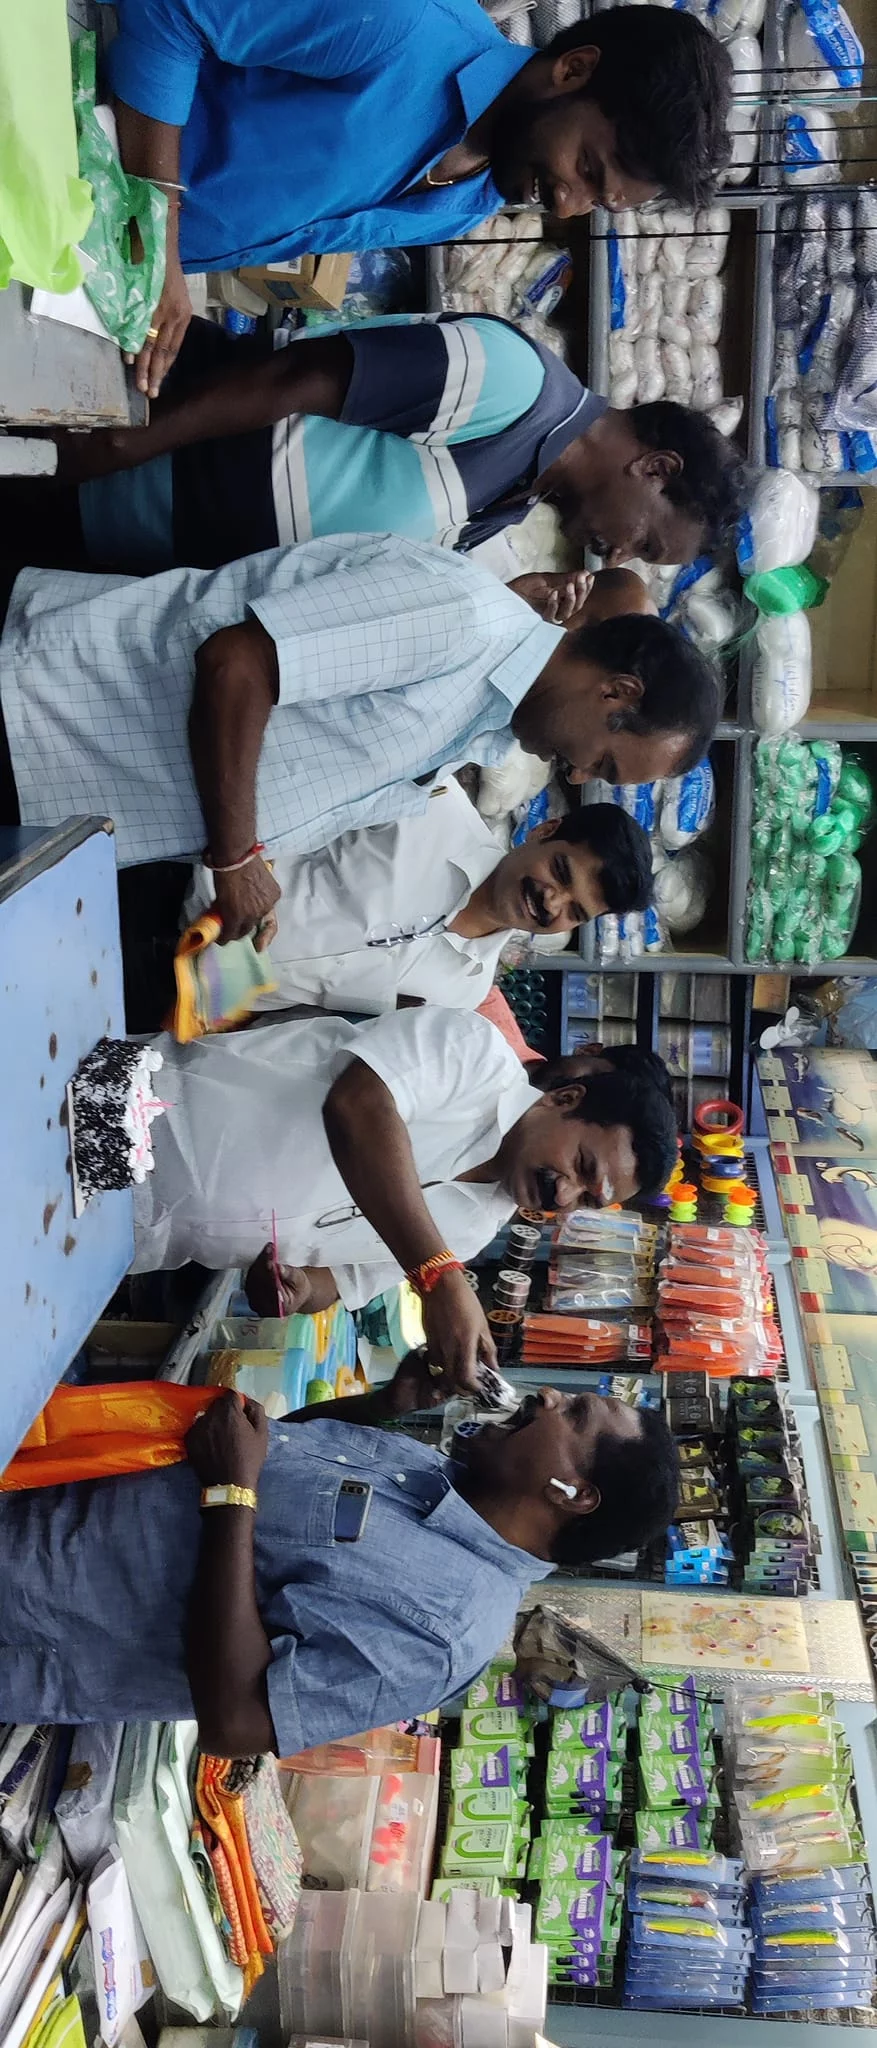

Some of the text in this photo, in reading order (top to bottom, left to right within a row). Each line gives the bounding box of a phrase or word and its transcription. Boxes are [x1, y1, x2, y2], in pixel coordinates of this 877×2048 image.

[674, 1721, 688, 1749] okuma
[677, 1760, 691, 1789] okuma
[582, 1842, 596, 1873] okuma
[576, 1888, 591, 1919] okuma
